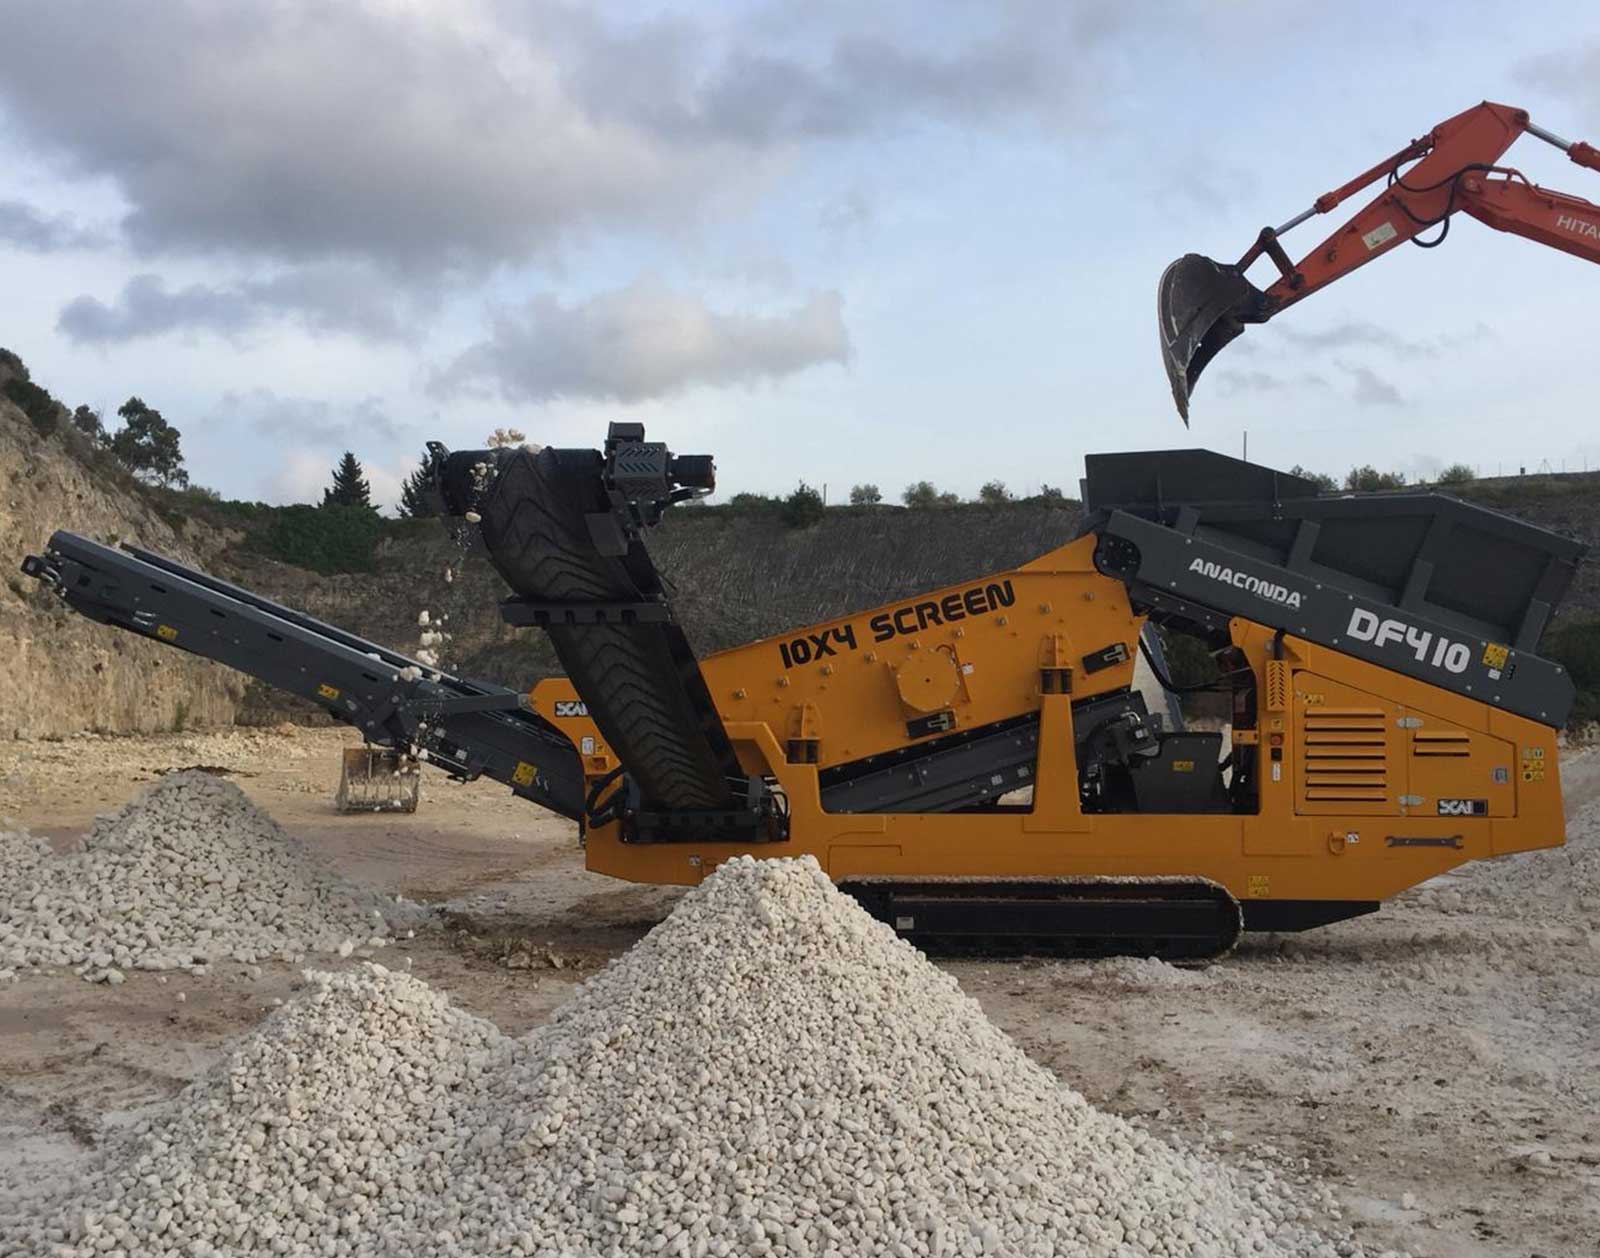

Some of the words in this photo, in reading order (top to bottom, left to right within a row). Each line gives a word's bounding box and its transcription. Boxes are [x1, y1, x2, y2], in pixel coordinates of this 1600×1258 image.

[1556, 215, 1600, 240] HITA
[1188, 558, 1301, 608] ANACONDA
[779, 624, 858, 669] 10X4
[870, 580, 1016, 643] SCREEN
[1346, 607, 1471, 673] DF410
